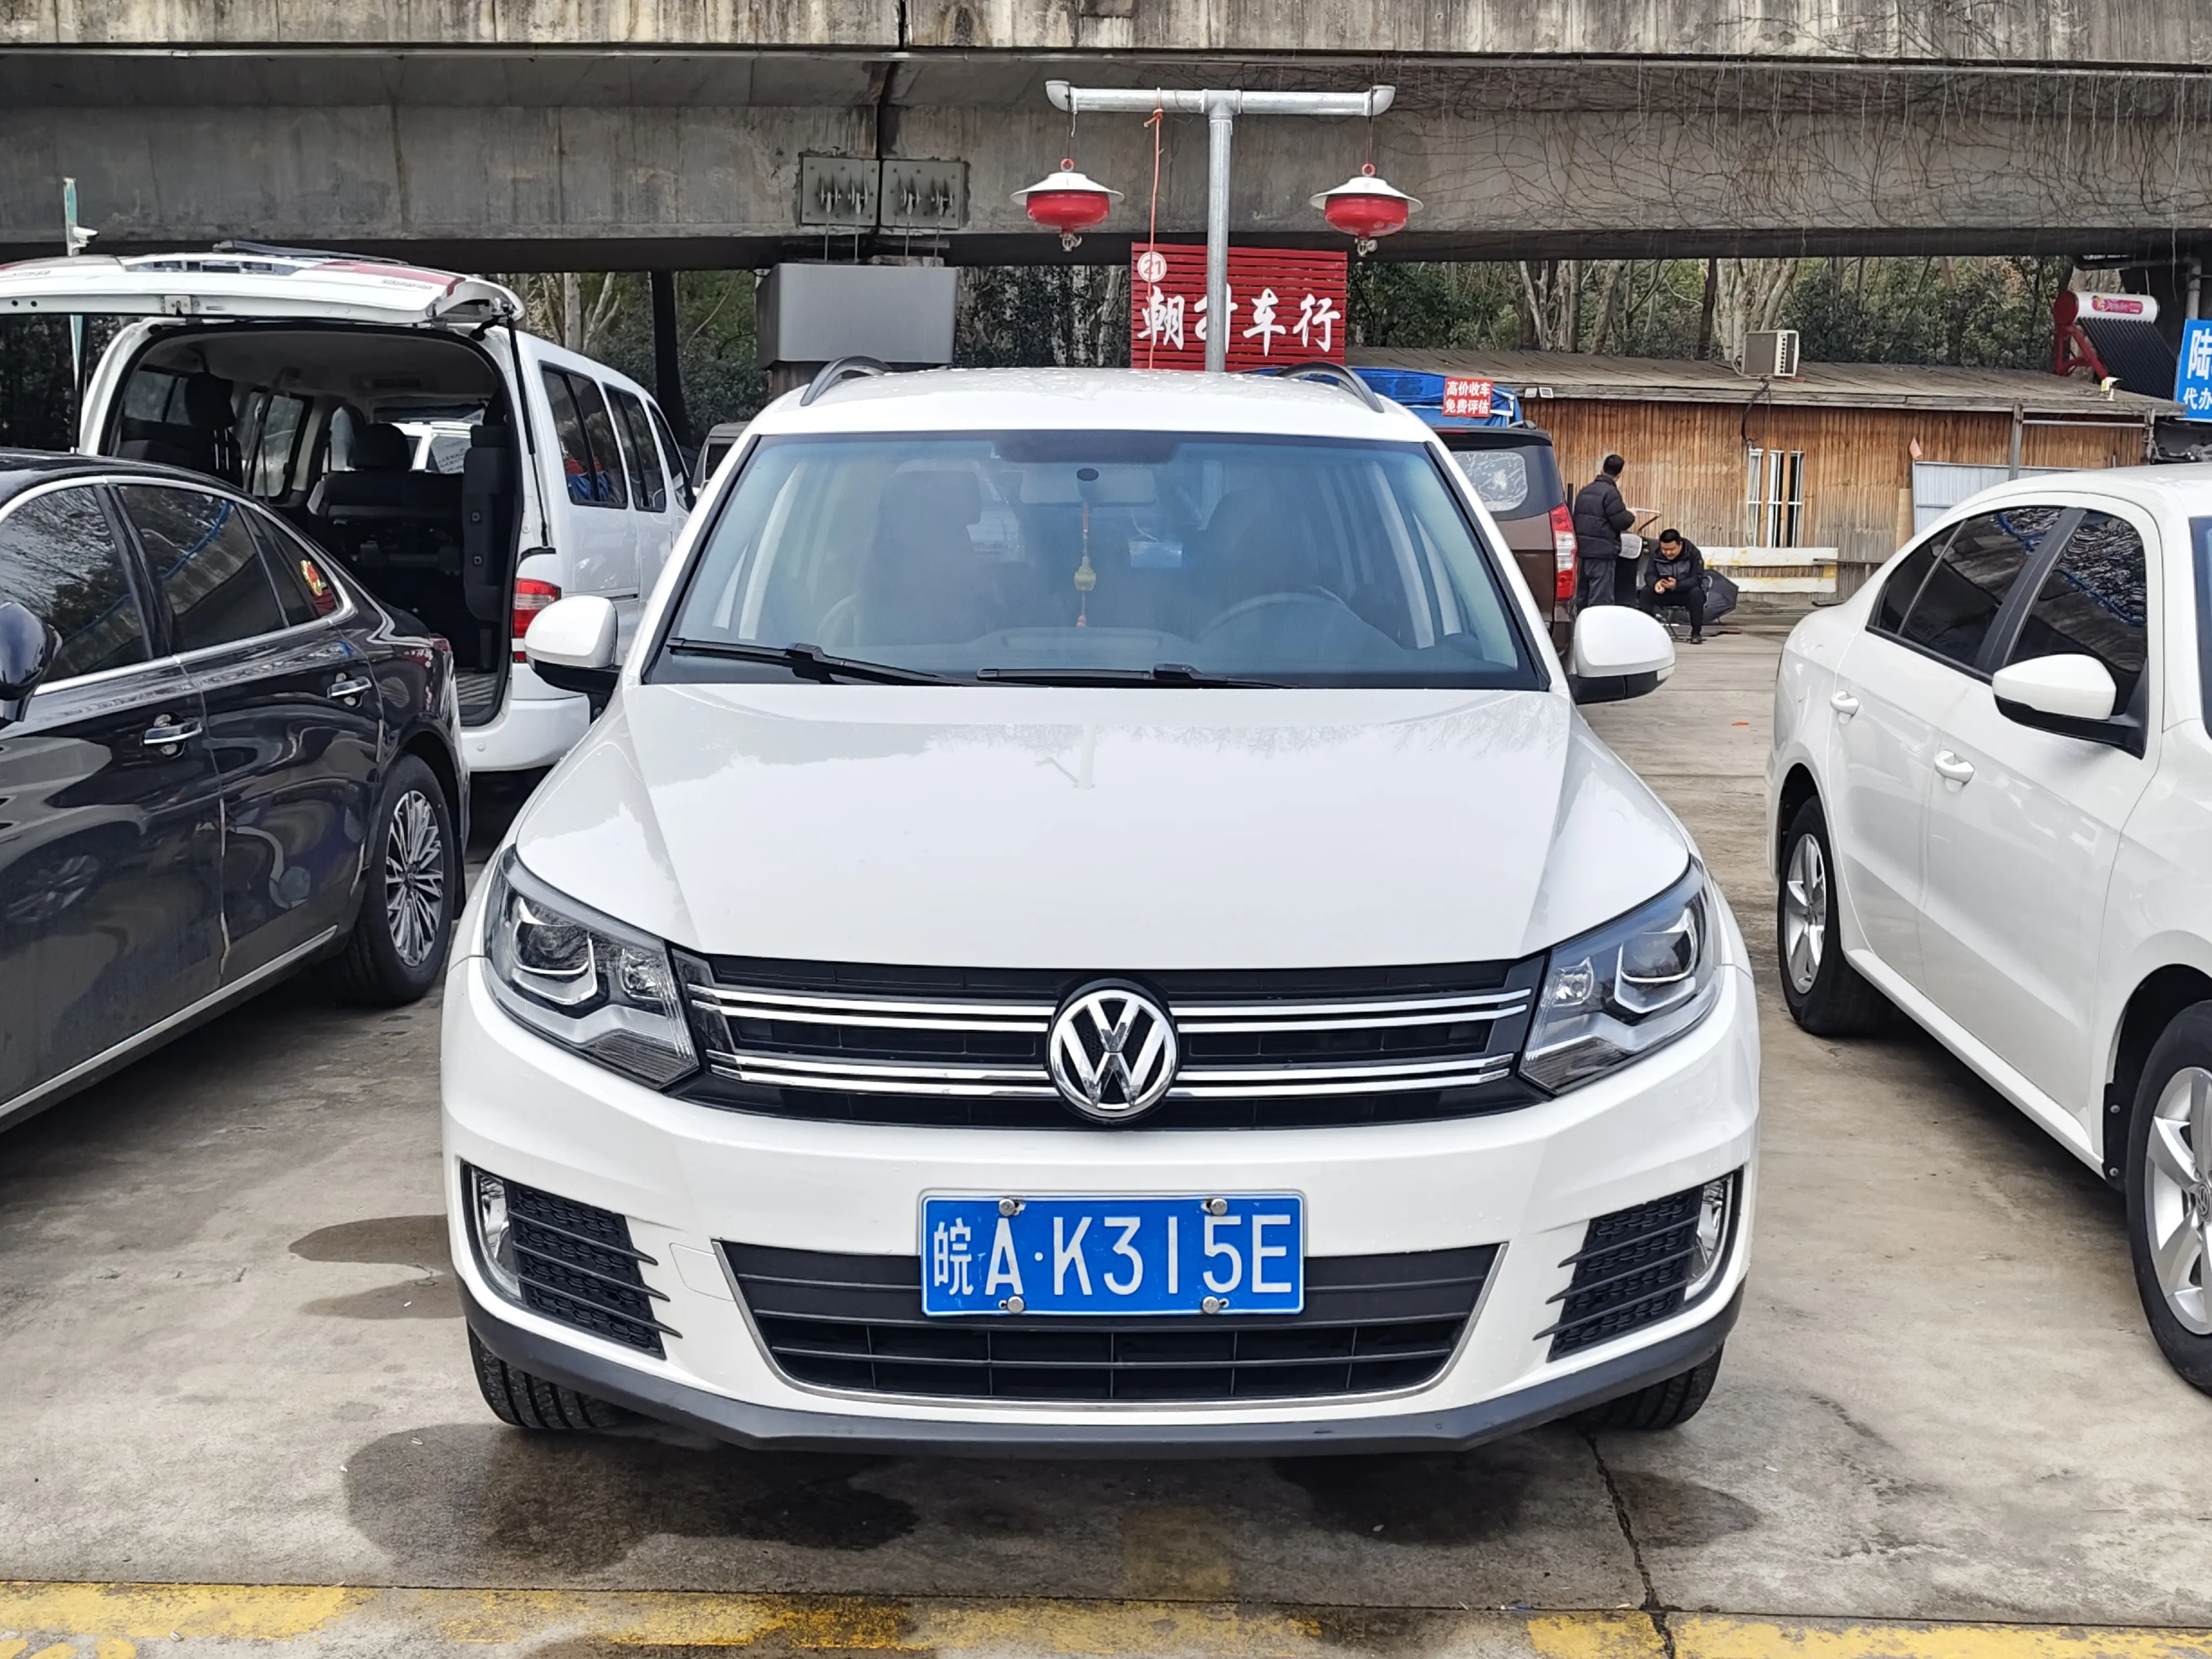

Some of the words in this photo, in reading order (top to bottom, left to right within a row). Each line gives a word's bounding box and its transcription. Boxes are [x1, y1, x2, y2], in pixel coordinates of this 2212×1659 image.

[1144, 259, 1161, 275] 21
[1447, 380, 1491, 397] 高价收车
[1445, 399, 1490, 414] 免费评估
[933, 1214, 1292, 1296] 皖A·K315E
